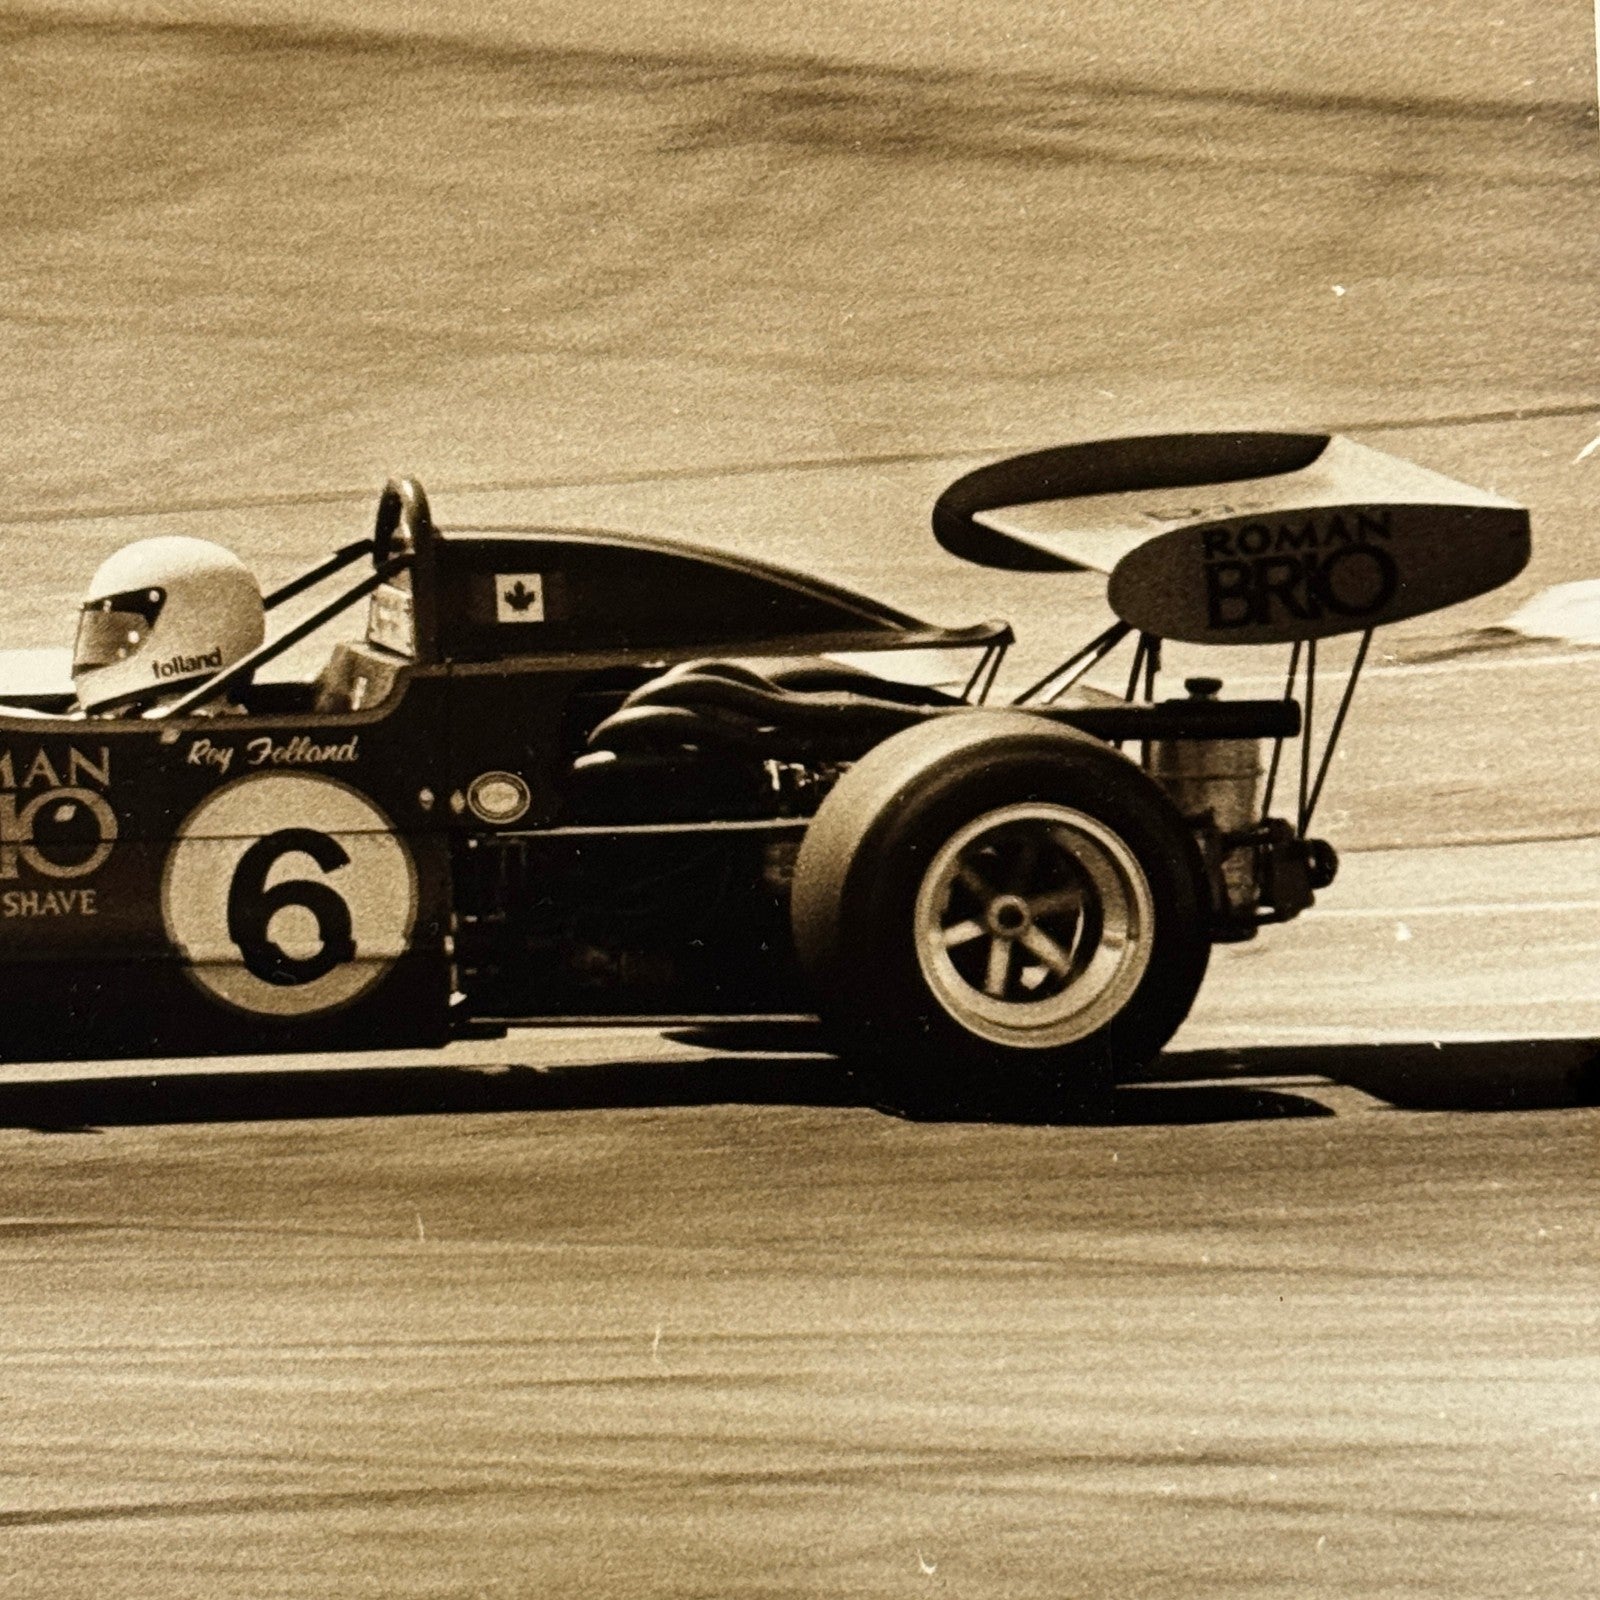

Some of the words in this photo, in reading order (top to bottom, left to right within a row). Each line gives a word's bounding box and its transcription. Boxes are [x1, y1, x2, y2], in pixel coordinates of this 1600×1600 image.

[1202, 509, 1392, 559] ROMAN
[1204, 543, 1399, 630] BRIO
[187, 738, 234, 774] Roy
[247, 735, 359, 765] Folland
[2, 889, 98, 917] SHAVE
[227, 828, 357, 987] 6
